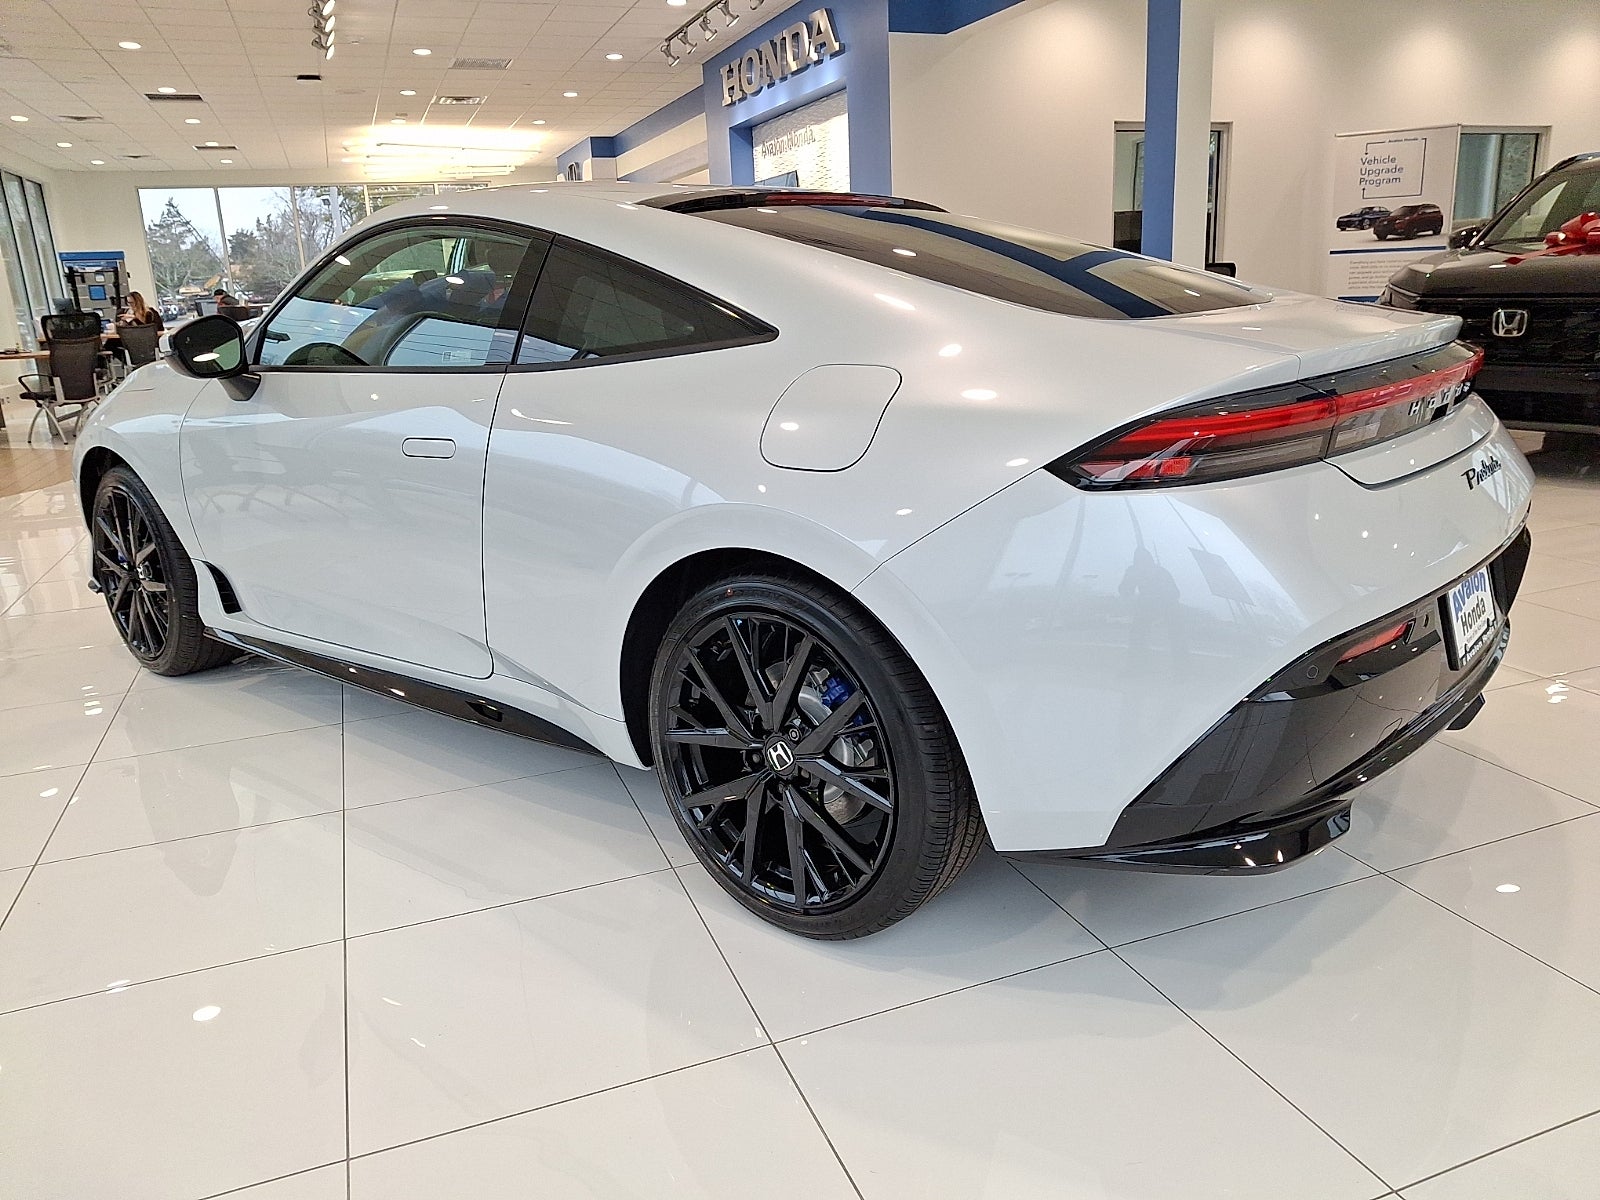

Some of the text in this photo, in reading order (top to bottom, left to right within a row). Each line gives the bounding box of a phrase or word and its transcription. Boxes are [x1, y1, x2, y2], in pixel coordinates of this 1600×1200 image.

[719, 8, 841, 107] HONDA
[761, 126, 815, 159] Avalon Honda
[1360, 155, 1397, 166] Vehicle
[1360, 164, 1404, 177] Upgrade
[1359, 177, 1401, 188] Program
[1452, 571, 1487, 623] Avalon
[1460, 595, 1487, 637] Honda
